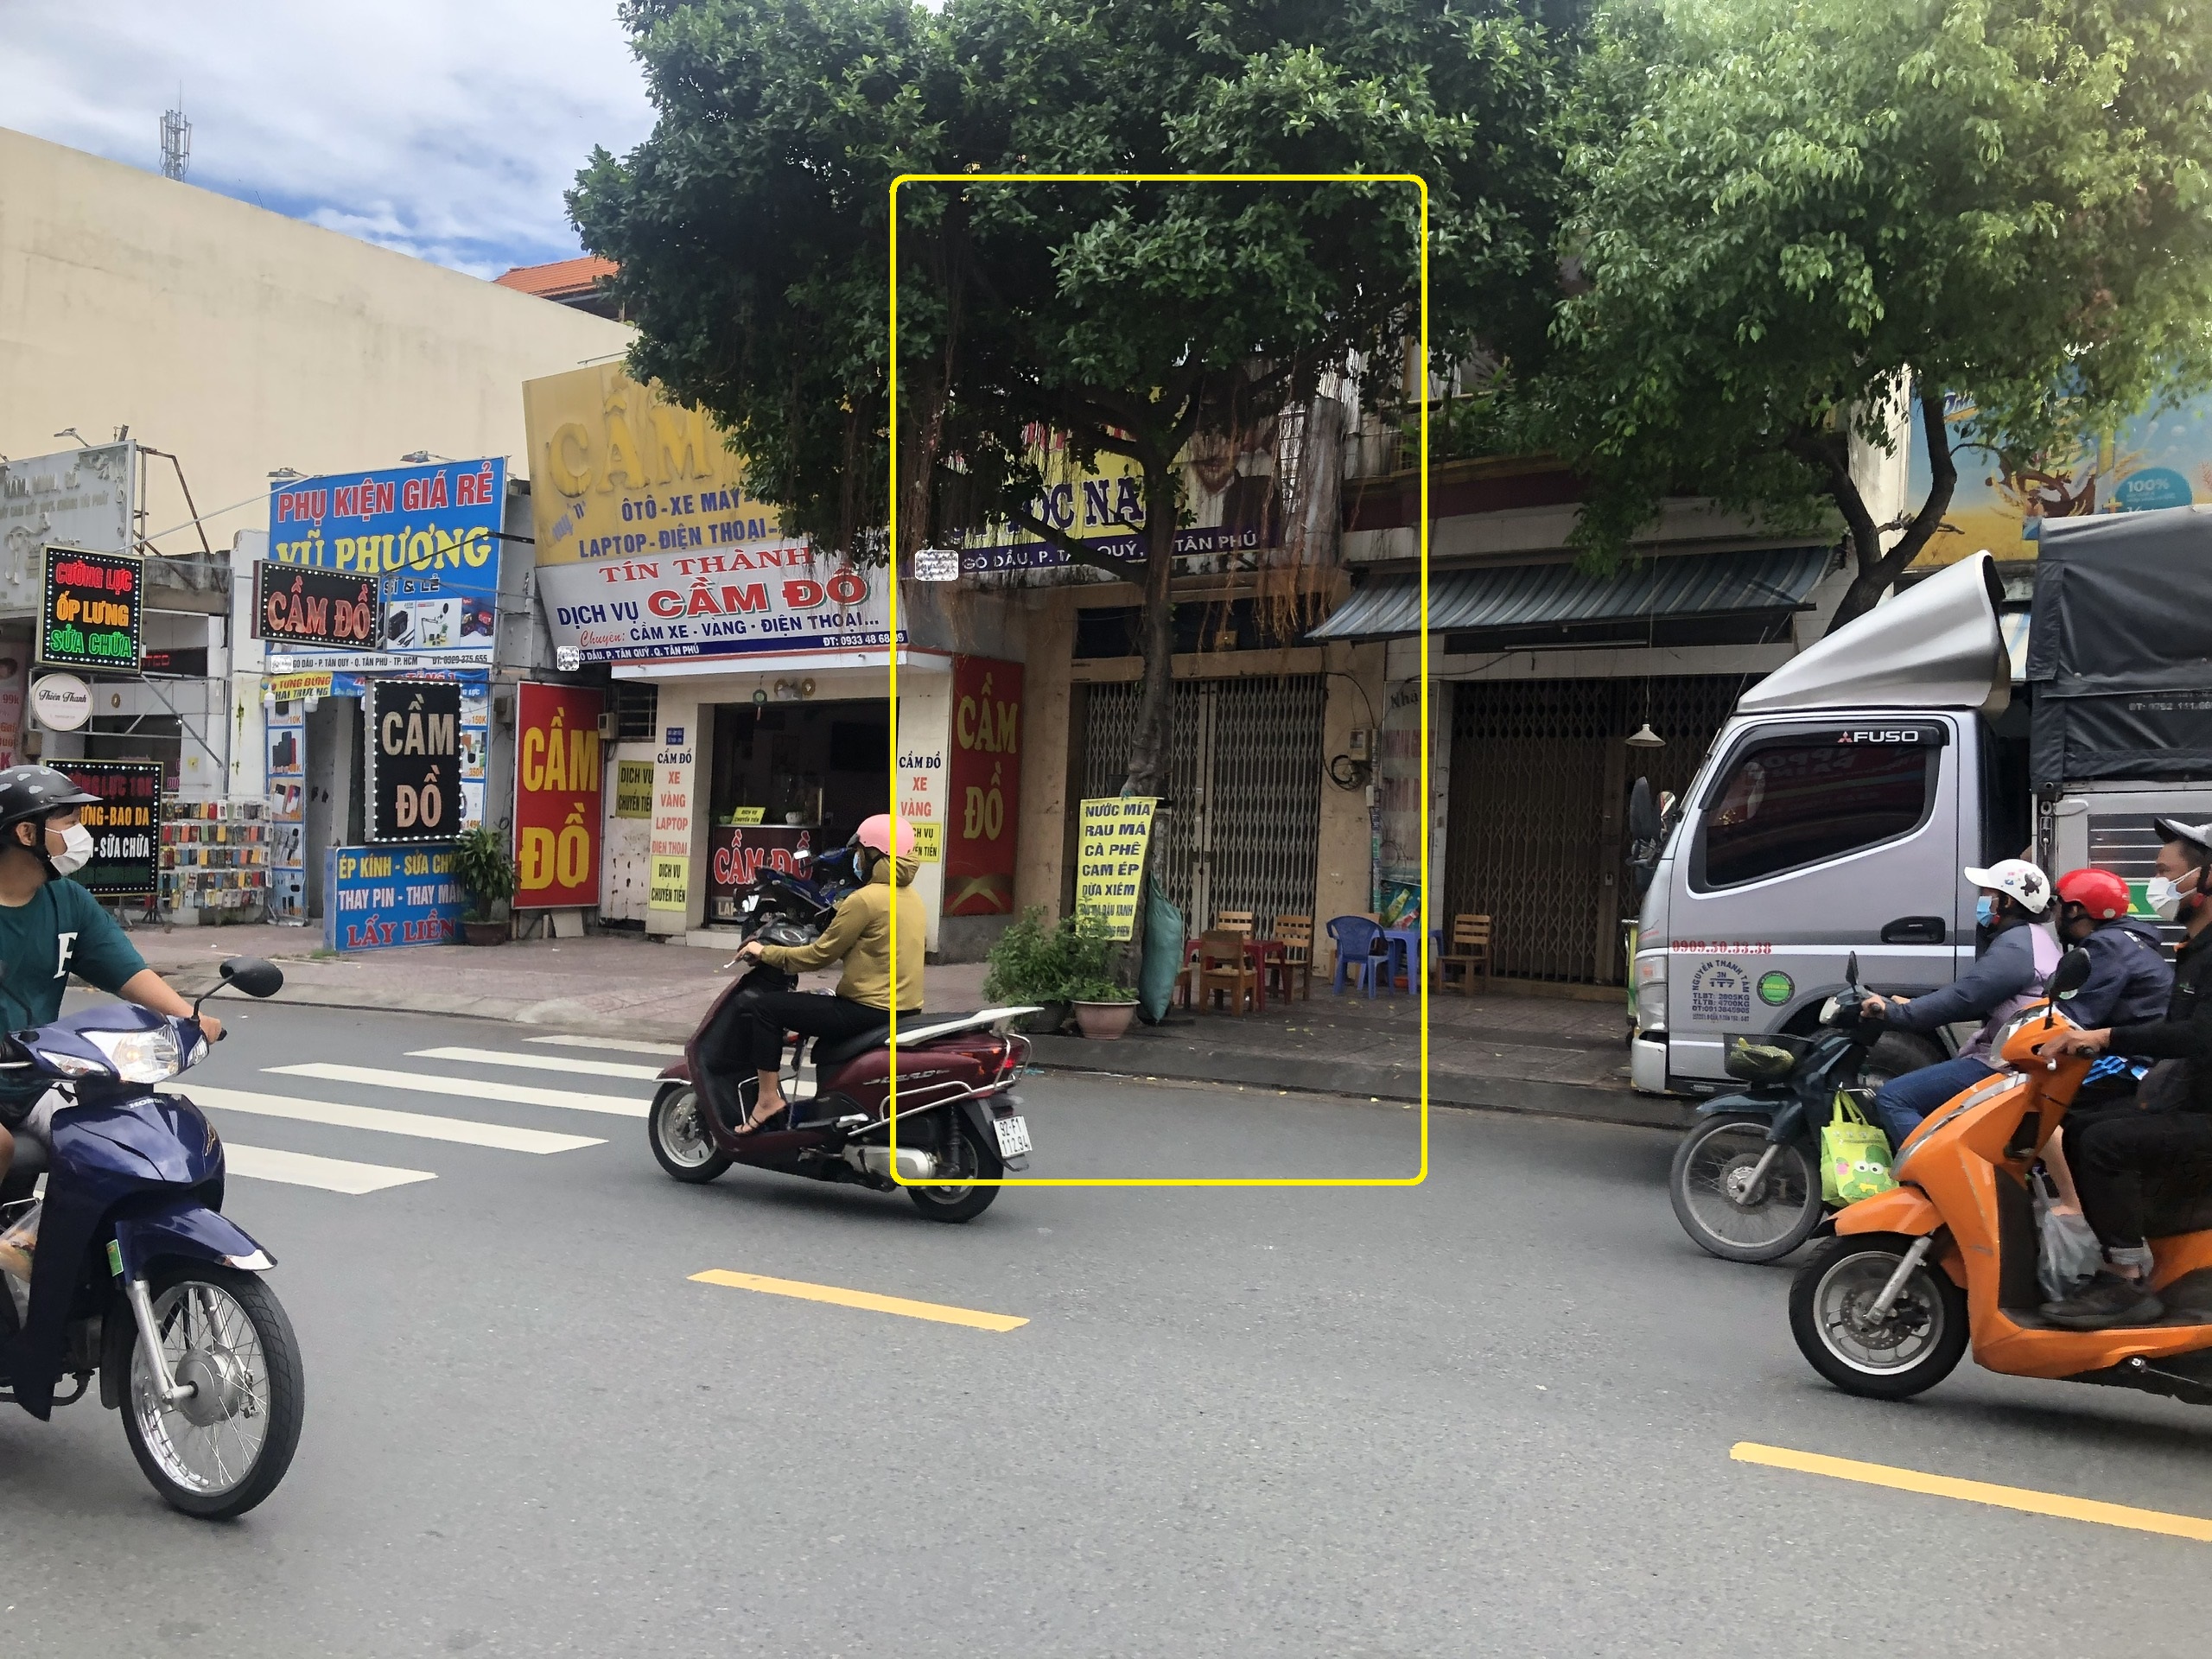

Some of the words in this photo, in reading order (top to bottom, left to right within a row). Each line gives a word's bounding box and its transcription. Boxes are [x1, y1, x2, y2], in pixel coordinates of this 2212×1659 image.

[277, 488, 327, 526] PHỤ
[334, 477, 394, 521] KIỆN
[402, 469, 448, 512] GIÁ
[456, 461, 493, 506] RẺ
[621, 493, 657, 522] ÔTÔ
[671, 493, 695, 517] XE
[701, 484, 740, 511] MÁY
[579, 533, 647, 558] LAPTOP
[658, 524, 702, 551] ĐIỆN
[708, 518, 766, 546] THOẠI
[1175, 536, 1212, 552] TÂN
[1218, 531, 1257, 550] PHÚ
[276, 529, 325, 568] VŨ
[334, 523, 492, 575] PHƯƠNG
[599, 558, 659, 584] TÍN
[673, 544, 817, 575] THÀNH
[55, 560, 104, 588] CƯỜNG
[106, 567, 133, 595] LỰC
[557, 605, 607, 630] DỊCH
[615, 601, 639, 624] VỤ
[647, 575, 772, 620] CẦM
[782, 561, 870, 610] ĐỒ
[56, 590, 80, 622] ỐP
[83, 600, 129, 626] LƯNG
[267, 575, 328, 634] CẦM
[334, 583, 371, 639] ĐỒ
[580, 629, 626, 647] Chuyên:
[630, 620, 664, 641] CẦM
[669, 624, 689, 639] XE
[702, 615, 747, 636] VÀNG
[761, 612, 802, 632] ĐIỆN
[823, 637, 839, 647] ĐT:
[841, 635, 863, 646] 0933
[865, 634, 877, 645] 48
[879, 633, 890, 644] 68
[50, 623, 85, 653] SỬA
[89, 632, 132, 658] CHỮA
[607, 650, 614, 659] P.
[615, 648, 632, 659] TÂN
[664, 645, 682, 657] TÂN
[683, 643, 700, 655] PHÚ
[404, 657, 418, 666] HCM
[275, 690, 290, 701] HAI
[957, 671, 1018, 754] CẦM
[382, 693, 454, 756] CẦM
[1853, 730, 1919, 742] FUSO
[523, 707, 600, 792] CẦM
[620, 767, 640, 786] DỊCH
[643, 768, 654, 788] VỤ
[669, 771, 681, 785] XE
[912, 776, 928, 791] XE
[395, 765, 442, 828] ĐỒ
[661, 790, 686, 808] VÀNG
[963, 760, 1004, 841] ĐỒ
[136, 806, 149, 826] DA
[900, 798, 931, 817] VÀNG
[1085, 803, 1120, 817] NƯỚC
[1123, 804, 1150, 816] MÍA
[656, 817, 688, 830] LAPTOP
[1085, 824, 1114, 837] RAU
[1118, 822, 1146, 836] MÁ
[924, 828, 934, 842] VỤ
[123, 834, 149, 858] CHỮA
[519, 802, 590, 890] ĐỒ
[1084, 842, 1104, 856] CÀ
[1109, 842, 1141, 856] PHÊ
[339, 854, 357, 879] ÉP
[359, 853, 392, 878] KÍNH
[404, 849, 429, 876] SỬA
[714, 829, 765, 885] CẦM
[658, 863, 672, 880] DỊCH
[673, 864, 681, 881] VỤ
[1083, 864, 1114, 877] CAM
[1118, 861, 1140, 876] ÉP
[339, 887, 369, 911] THAY
[372, 887, 395, 908] PIN
[406, 884, 435, 906] THAY
[1083, 881, 1103, 896] DỪA
[1105, 881, 1136, 896] XIÊM
[346, 913, 397, 948] LẤY
[403, 908, 456, 943] LIỀN
[1715, 959, 1743, 975] THANH
[129, 1097, 165, 1109] HONDA
[999, 1117, 1021, 1137] 92-F1
